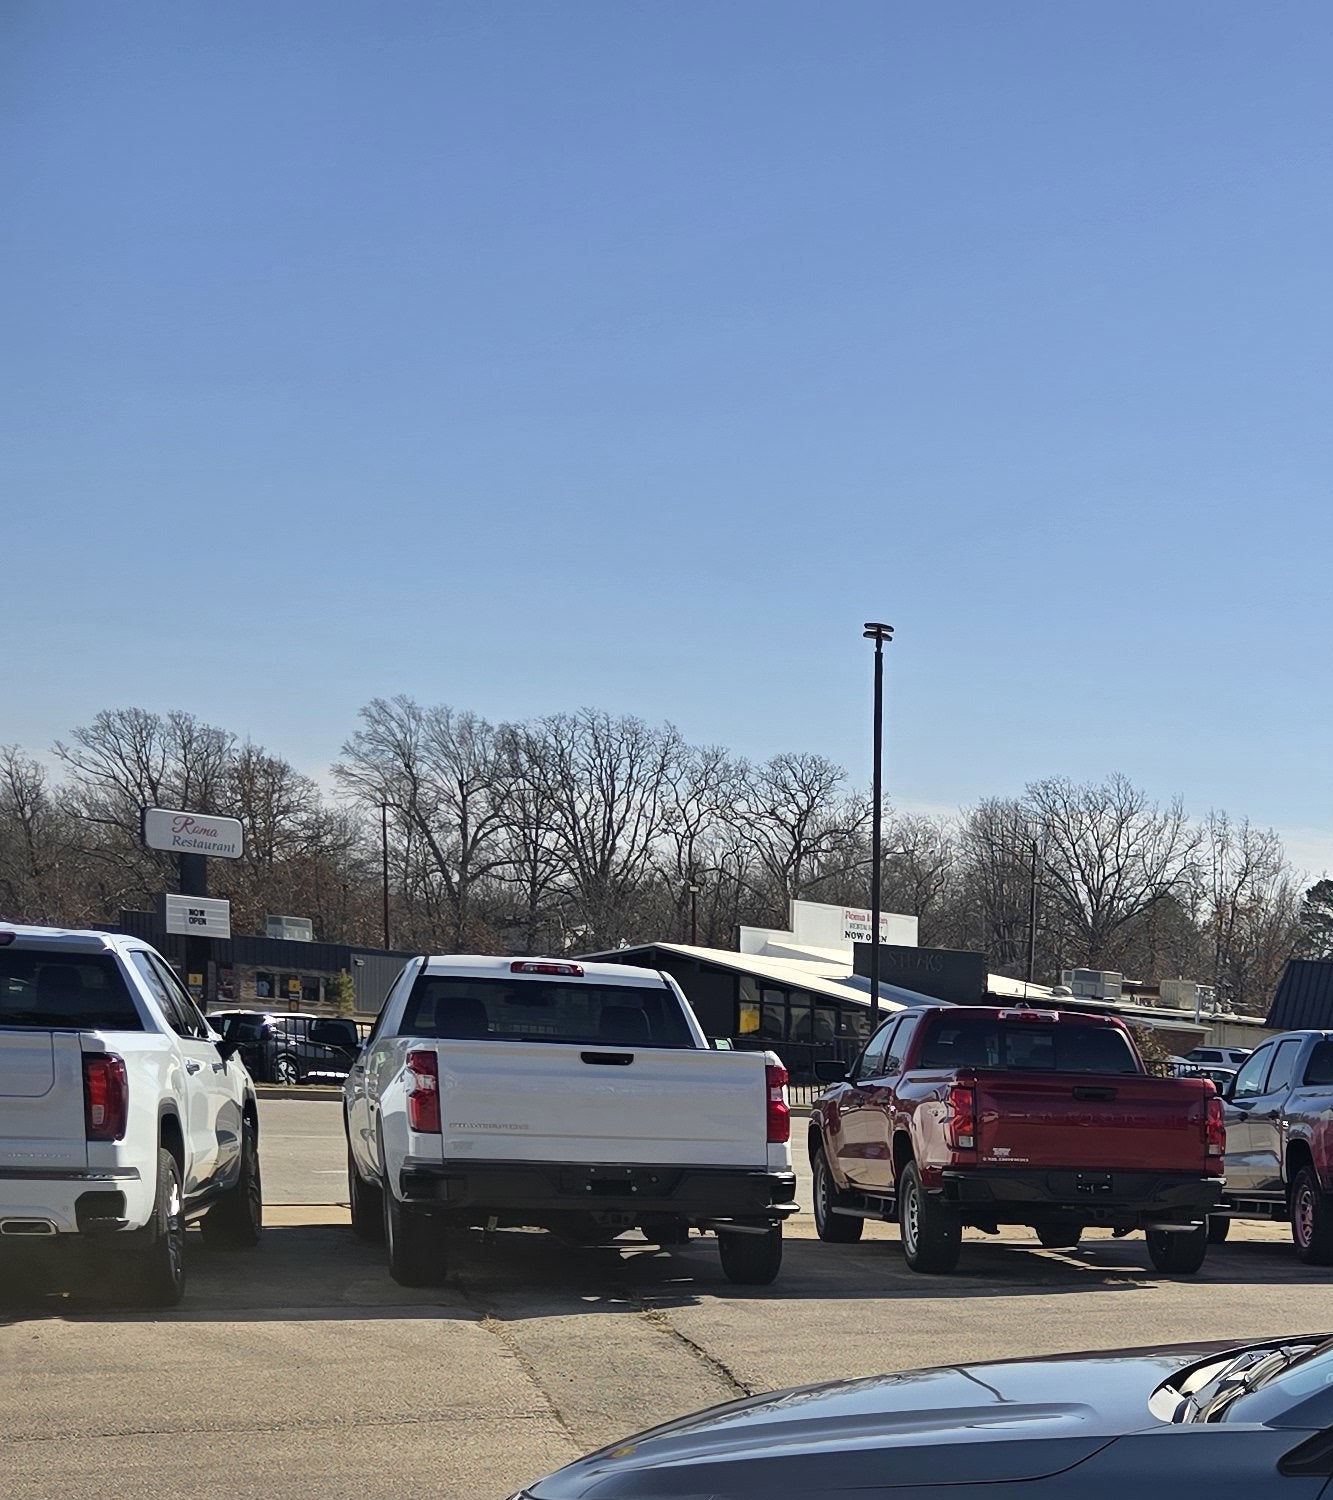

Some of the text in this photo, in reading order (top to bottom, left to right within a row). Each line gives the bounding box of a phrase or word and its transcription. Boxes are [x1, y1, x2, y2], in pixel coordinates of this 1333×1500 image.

[172, 815, 219, 838] Roma
[172, 835, 235, 853] Restaurant
[188, 909, 206, 917] NOW
[188, 917, 207, 925] OPEN
[844, 930, 888, 943] NOW ON
